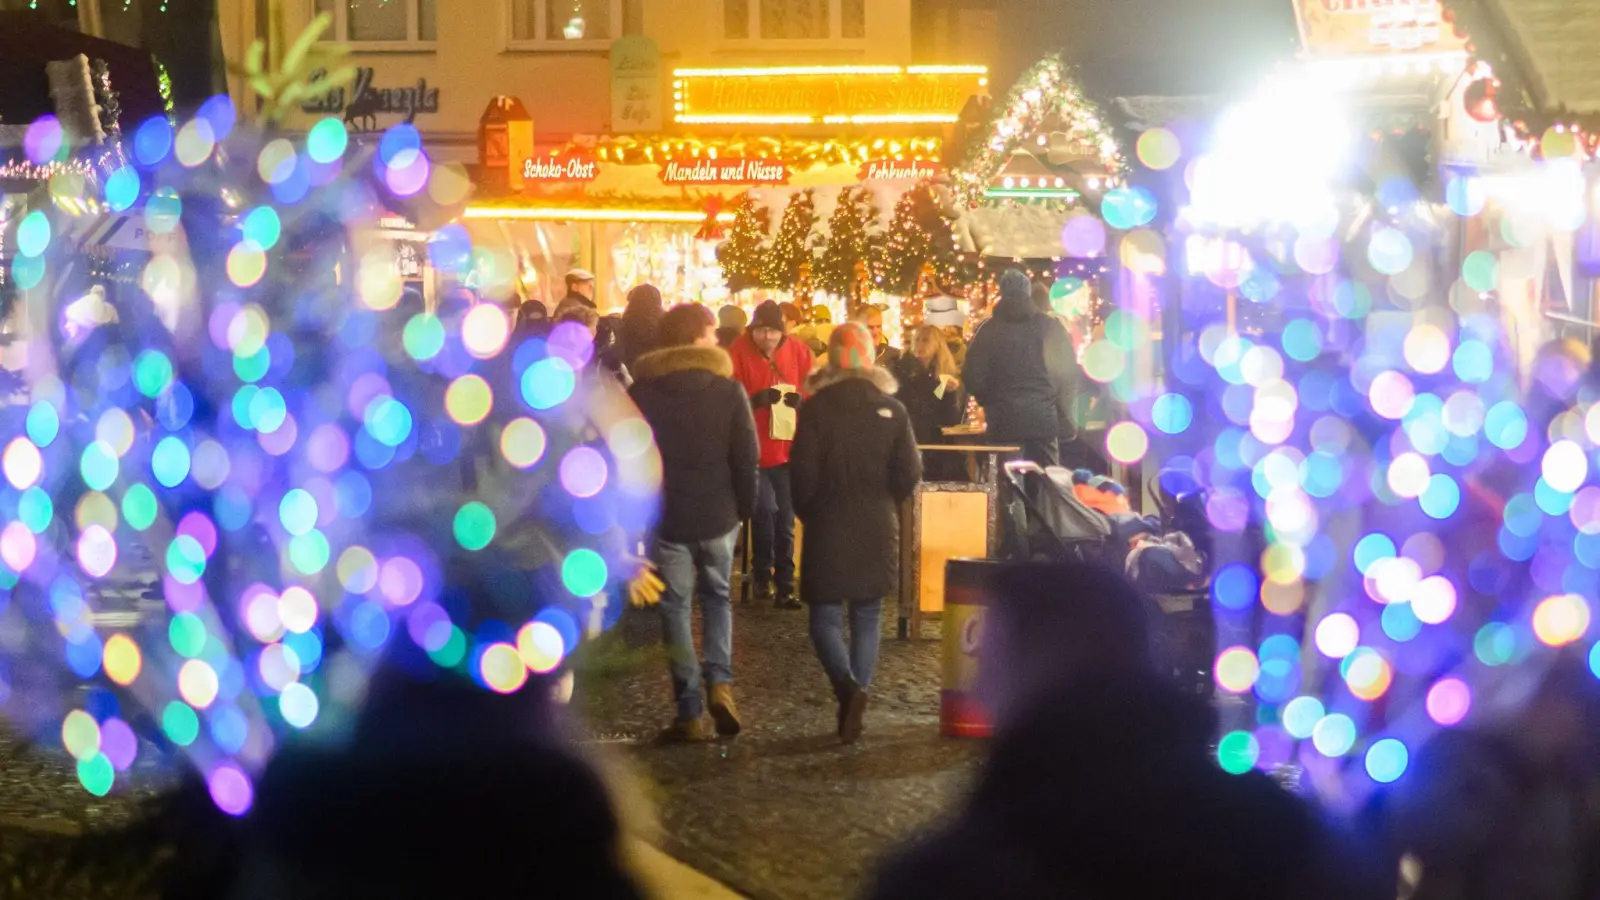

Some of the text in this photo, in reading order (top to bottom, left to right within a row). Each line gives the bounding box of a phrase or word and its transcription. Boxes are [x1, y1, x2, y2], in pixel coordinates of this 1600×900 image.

[523, 157, 595, 178] Schoko-Obst
[663, 159, 784, 181] Mandeln und Nüsse
